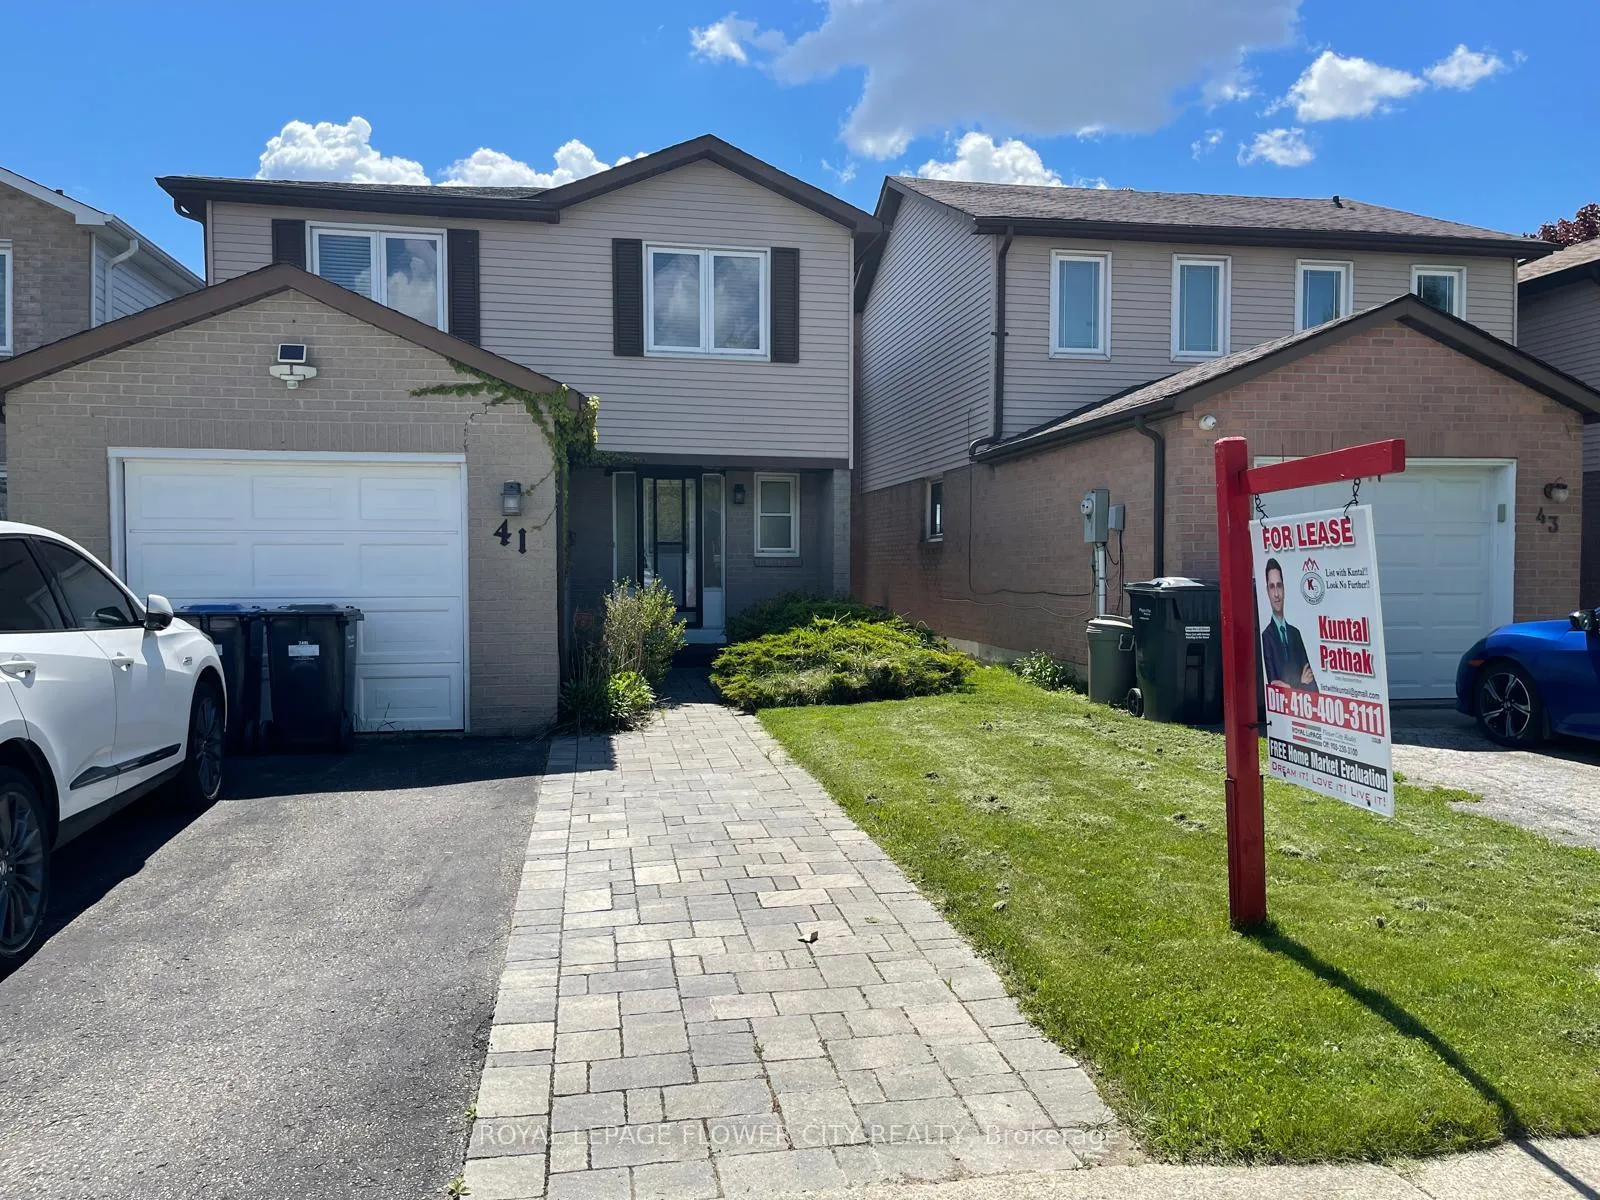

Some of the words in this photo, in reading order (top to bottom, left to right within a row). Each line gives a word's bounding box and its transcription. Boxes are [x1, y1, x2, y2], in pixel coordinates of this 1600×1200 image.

[1262, 525, 1294, 552] FOR
[1296, 517, 1354, 549] LEASE
[1536, 506, 1559, 533] 43
[493, 518, 527, 554] 41
[1325, 568, 1335, 577] List
[1336, 568, 1347, 577] with
[1326, 580, 1339, 589] Look
[1339, 580, 1347, 589] No
[1318, 615, 1370, 644] Kuntal
[1319, 644, 1374, 676] Pathak
[1267, 686, 1289, 714] Dir:
[1290, 691, 1383, 735] 416-400-3111
[1292, 726, 1306, 736] ROYAL
[1270, 739, 1287, 759] FREE
[1287, 745, 1309, 767] Home
[1310, 751, 1339, 776] Market
[1340, 760, 1387, 790] Evaluation
[1271, 761, 1297, 776] DREAM
[1312, 775, 1333, 789] LOVE
[1350, 786, 1370, 799] LIVE
